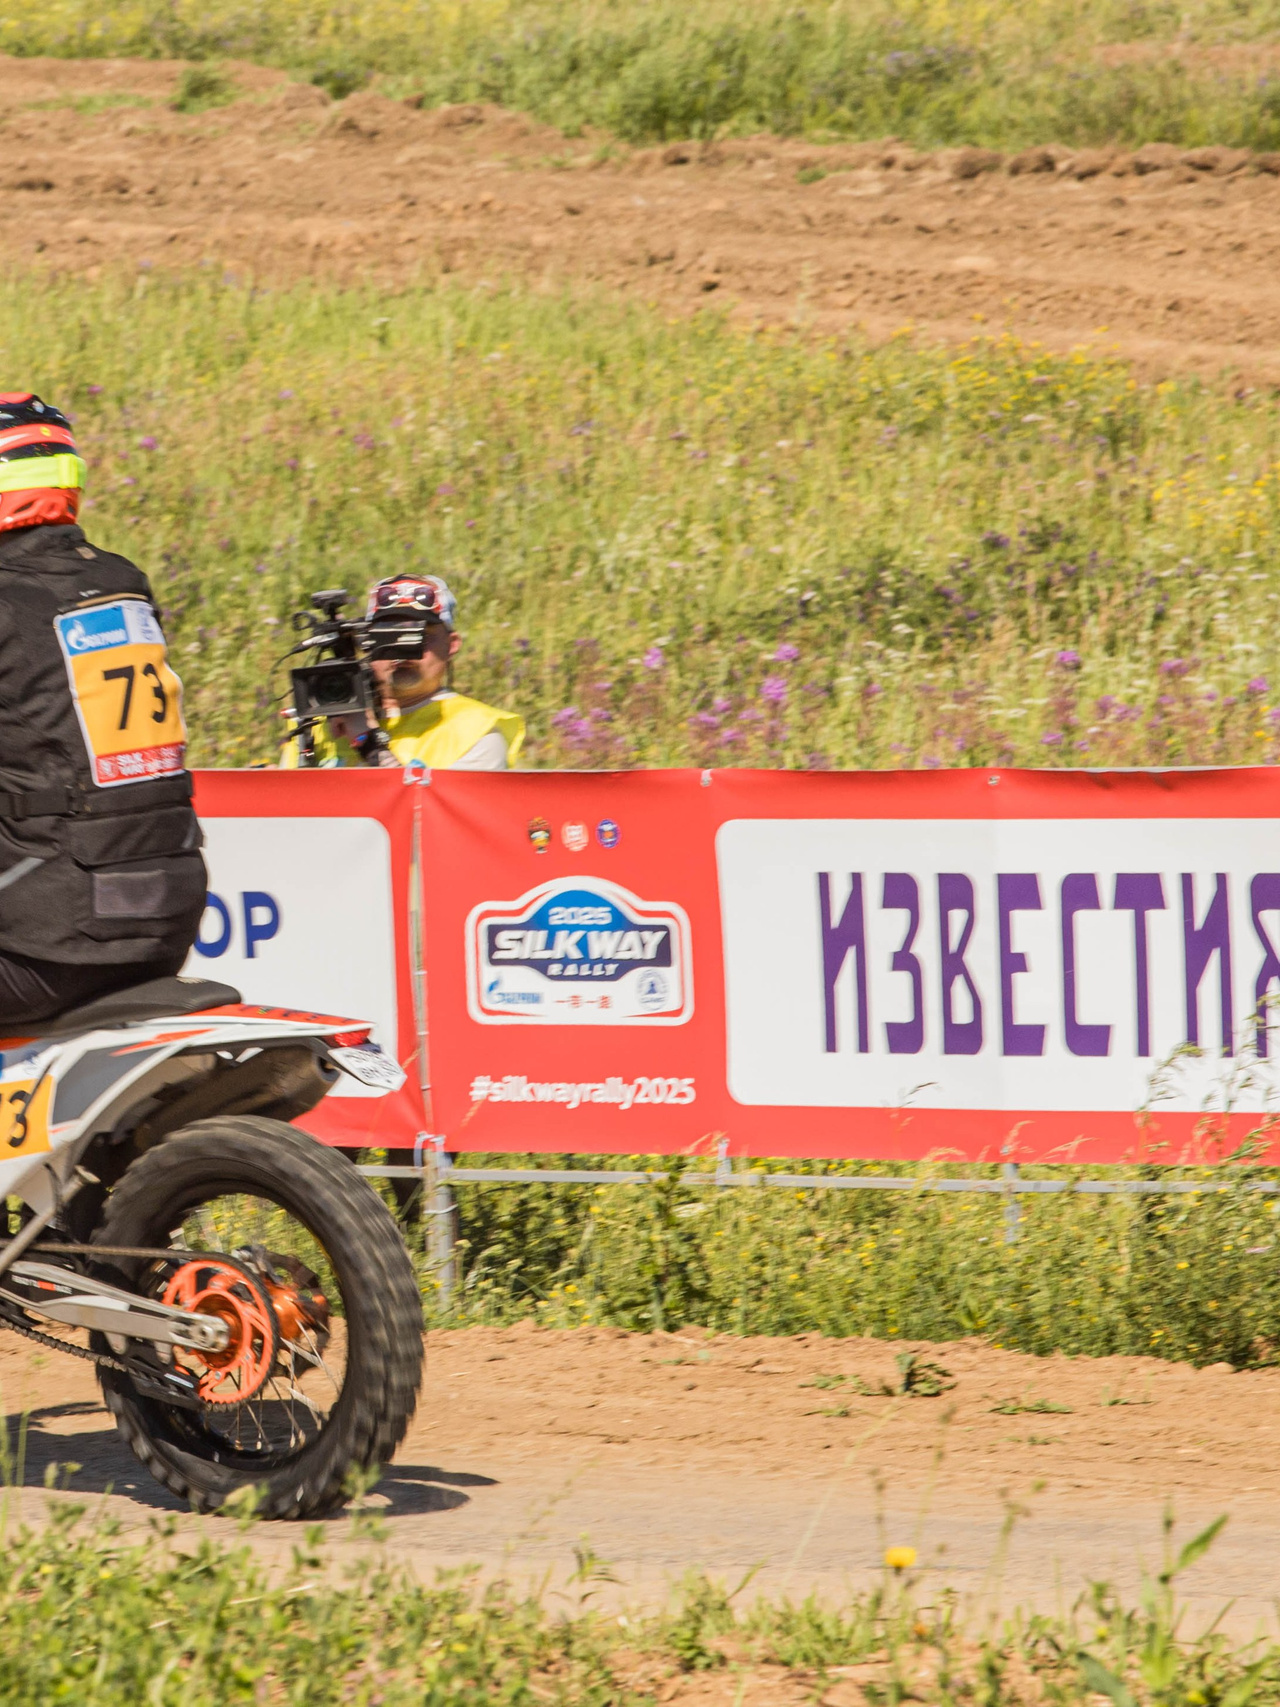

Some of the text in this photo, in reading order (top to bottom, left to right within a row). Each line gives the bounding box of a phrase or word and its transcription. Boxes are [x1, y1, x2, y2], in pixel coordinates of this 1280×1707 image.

[102, 662, 167, 730] 73
[547, 906, 613, 926] 2025
[491, 930, 669, 960] SILK WAY
[547, 963, 620, 977] RALLY
[469, 1075, 697, 1110] #silkwayrally2025
